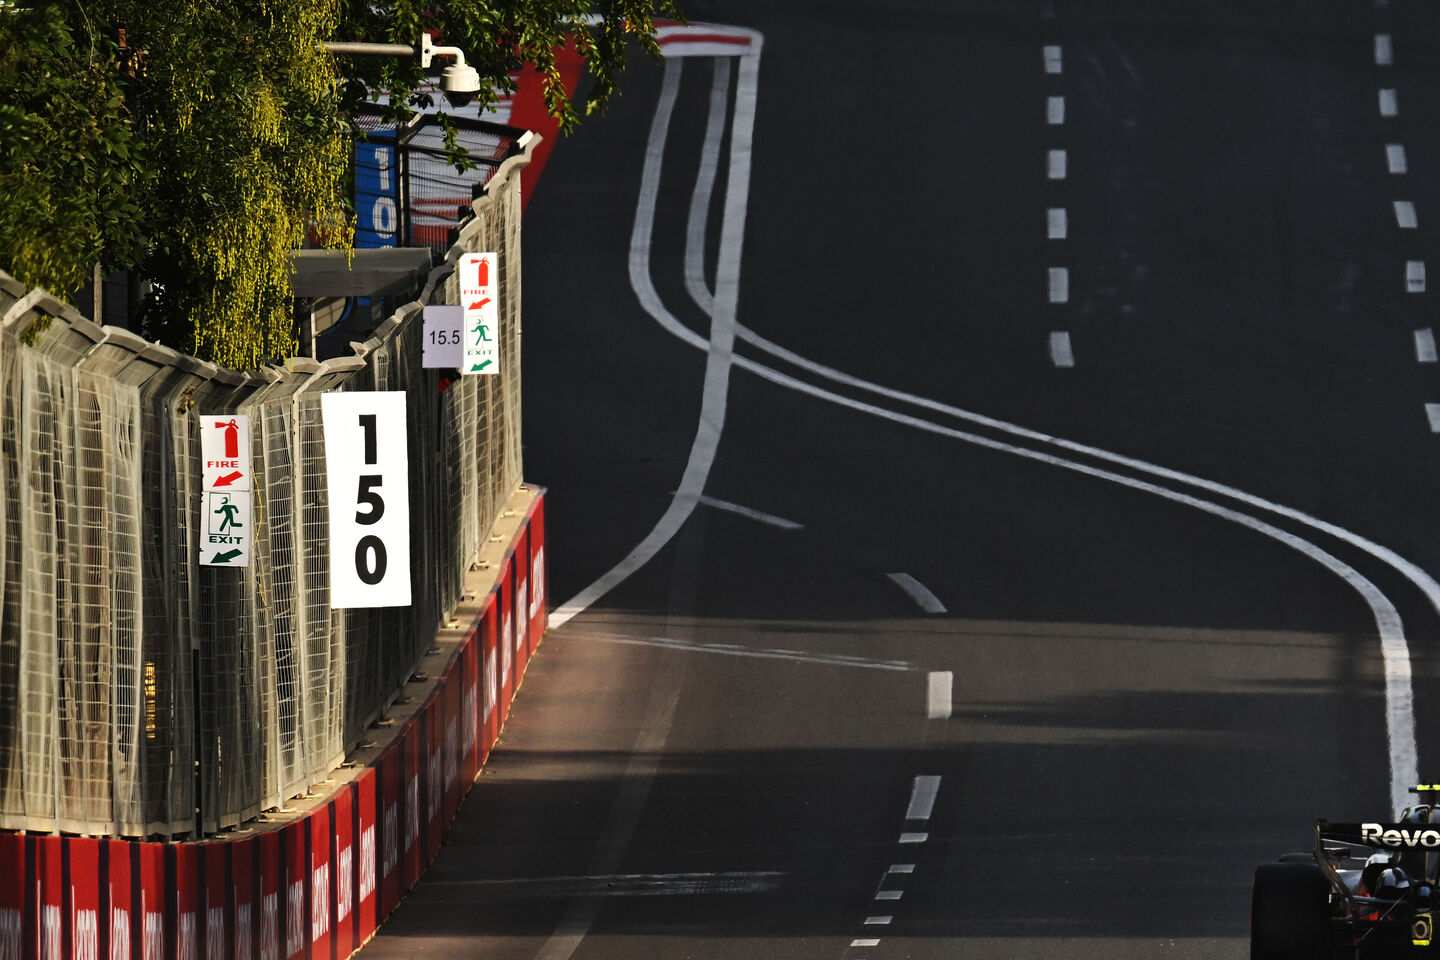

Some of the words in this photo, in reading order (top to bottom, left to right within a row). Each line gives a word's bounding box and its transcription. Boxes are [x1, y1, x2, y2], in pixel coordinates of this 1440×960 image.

[372, 147, 398, 248] 10
[429, 330, 460, 345] 15.5
[207, 460, 239, 468] FIRE
[354, 414, 388, 586] 150
[208, 535, 244, 545] EXIT
